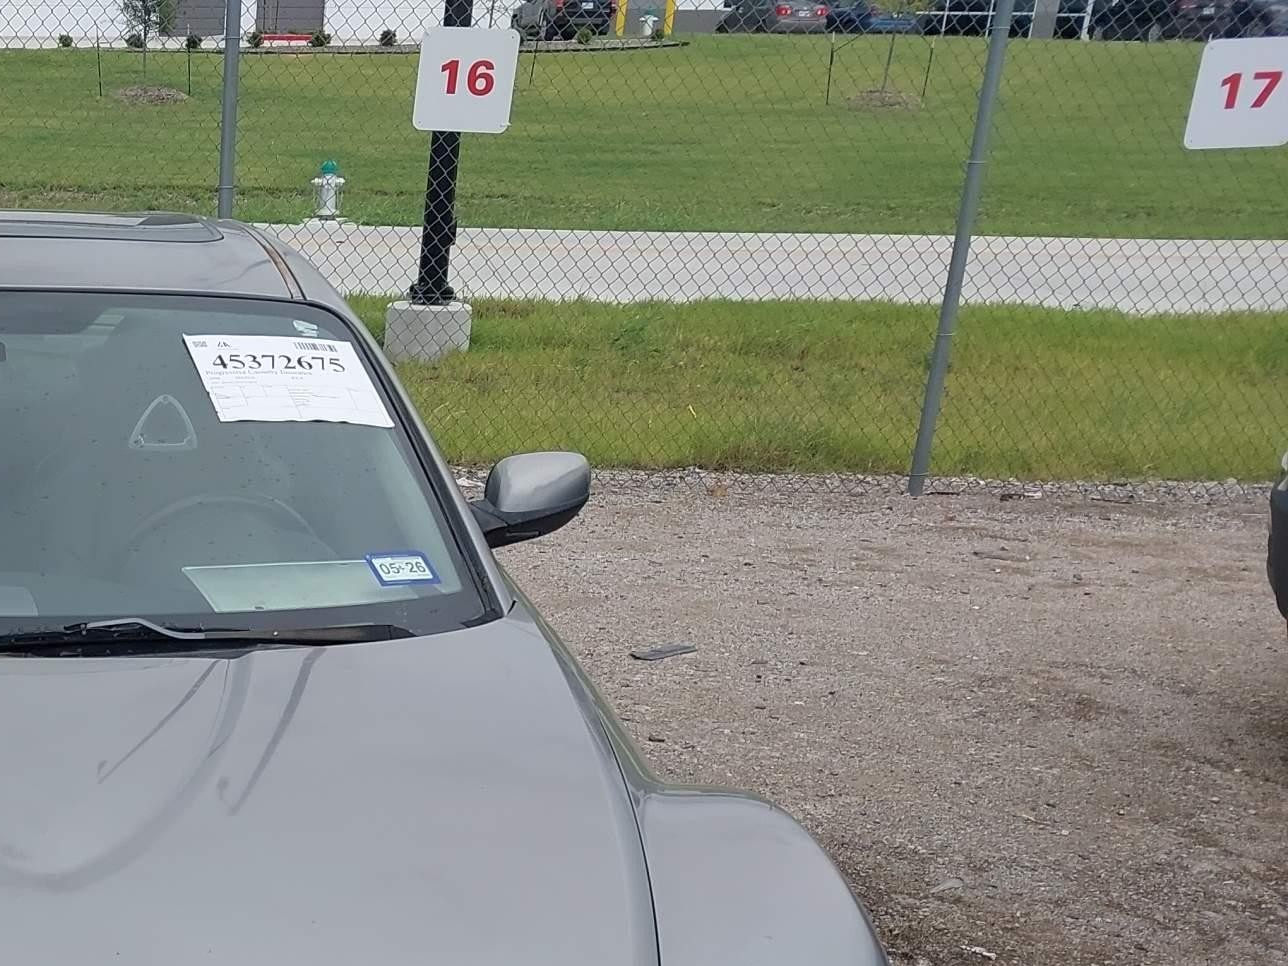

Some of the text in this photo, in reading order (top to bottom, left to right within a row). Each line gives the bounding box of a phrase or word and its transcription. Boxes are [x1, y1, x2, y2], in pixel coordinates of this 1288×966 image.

[441, 60, 494, 96] 16
[1220, 71, 1283, 109] 17
[212, 354, 345, 373] 45372675
